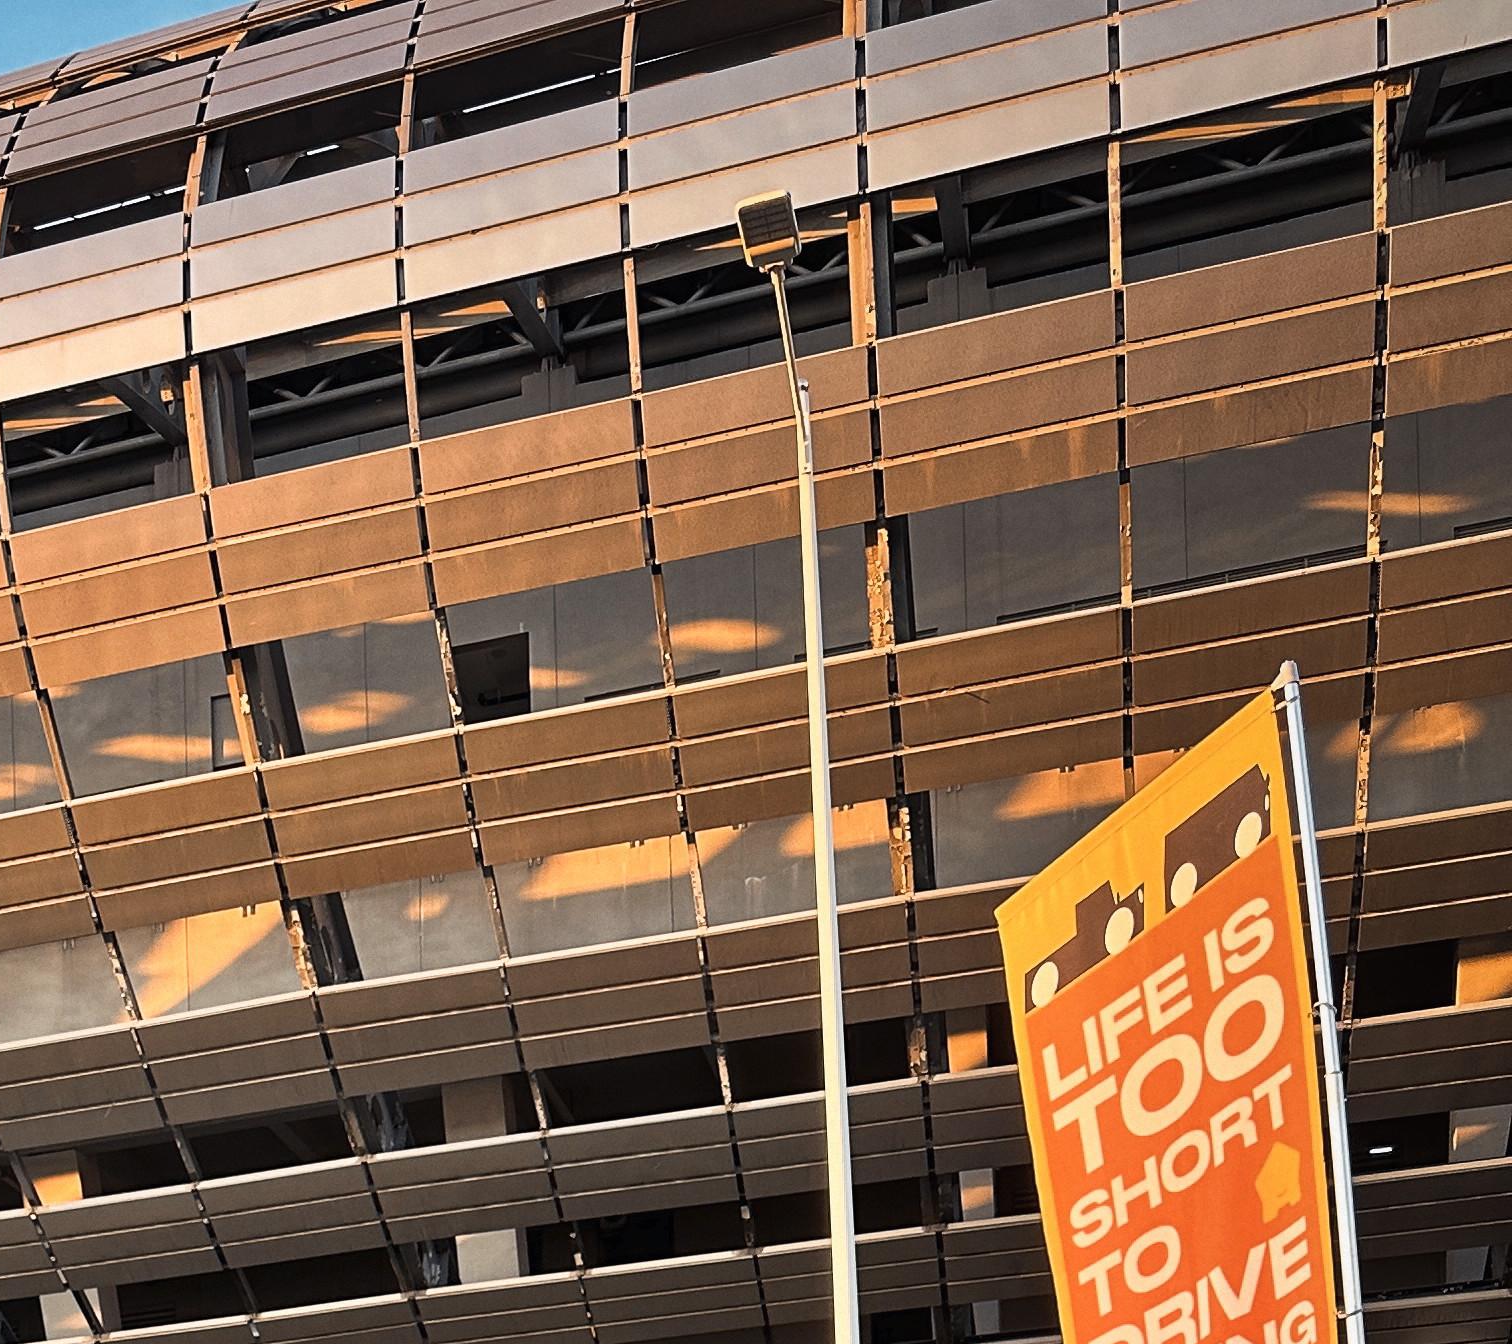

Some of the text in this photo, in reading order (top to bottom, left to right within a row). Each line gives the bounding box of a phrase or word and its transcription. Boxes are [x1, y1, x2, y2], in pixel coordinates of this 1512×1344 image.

[1041, 897, 1276, 1102] LIFE IS
[1053, 974, 1285, 1175] TOO
[1069, 1064, 1293, 1248] SHORT
[1078, 1224, 1181, 1317] TO
